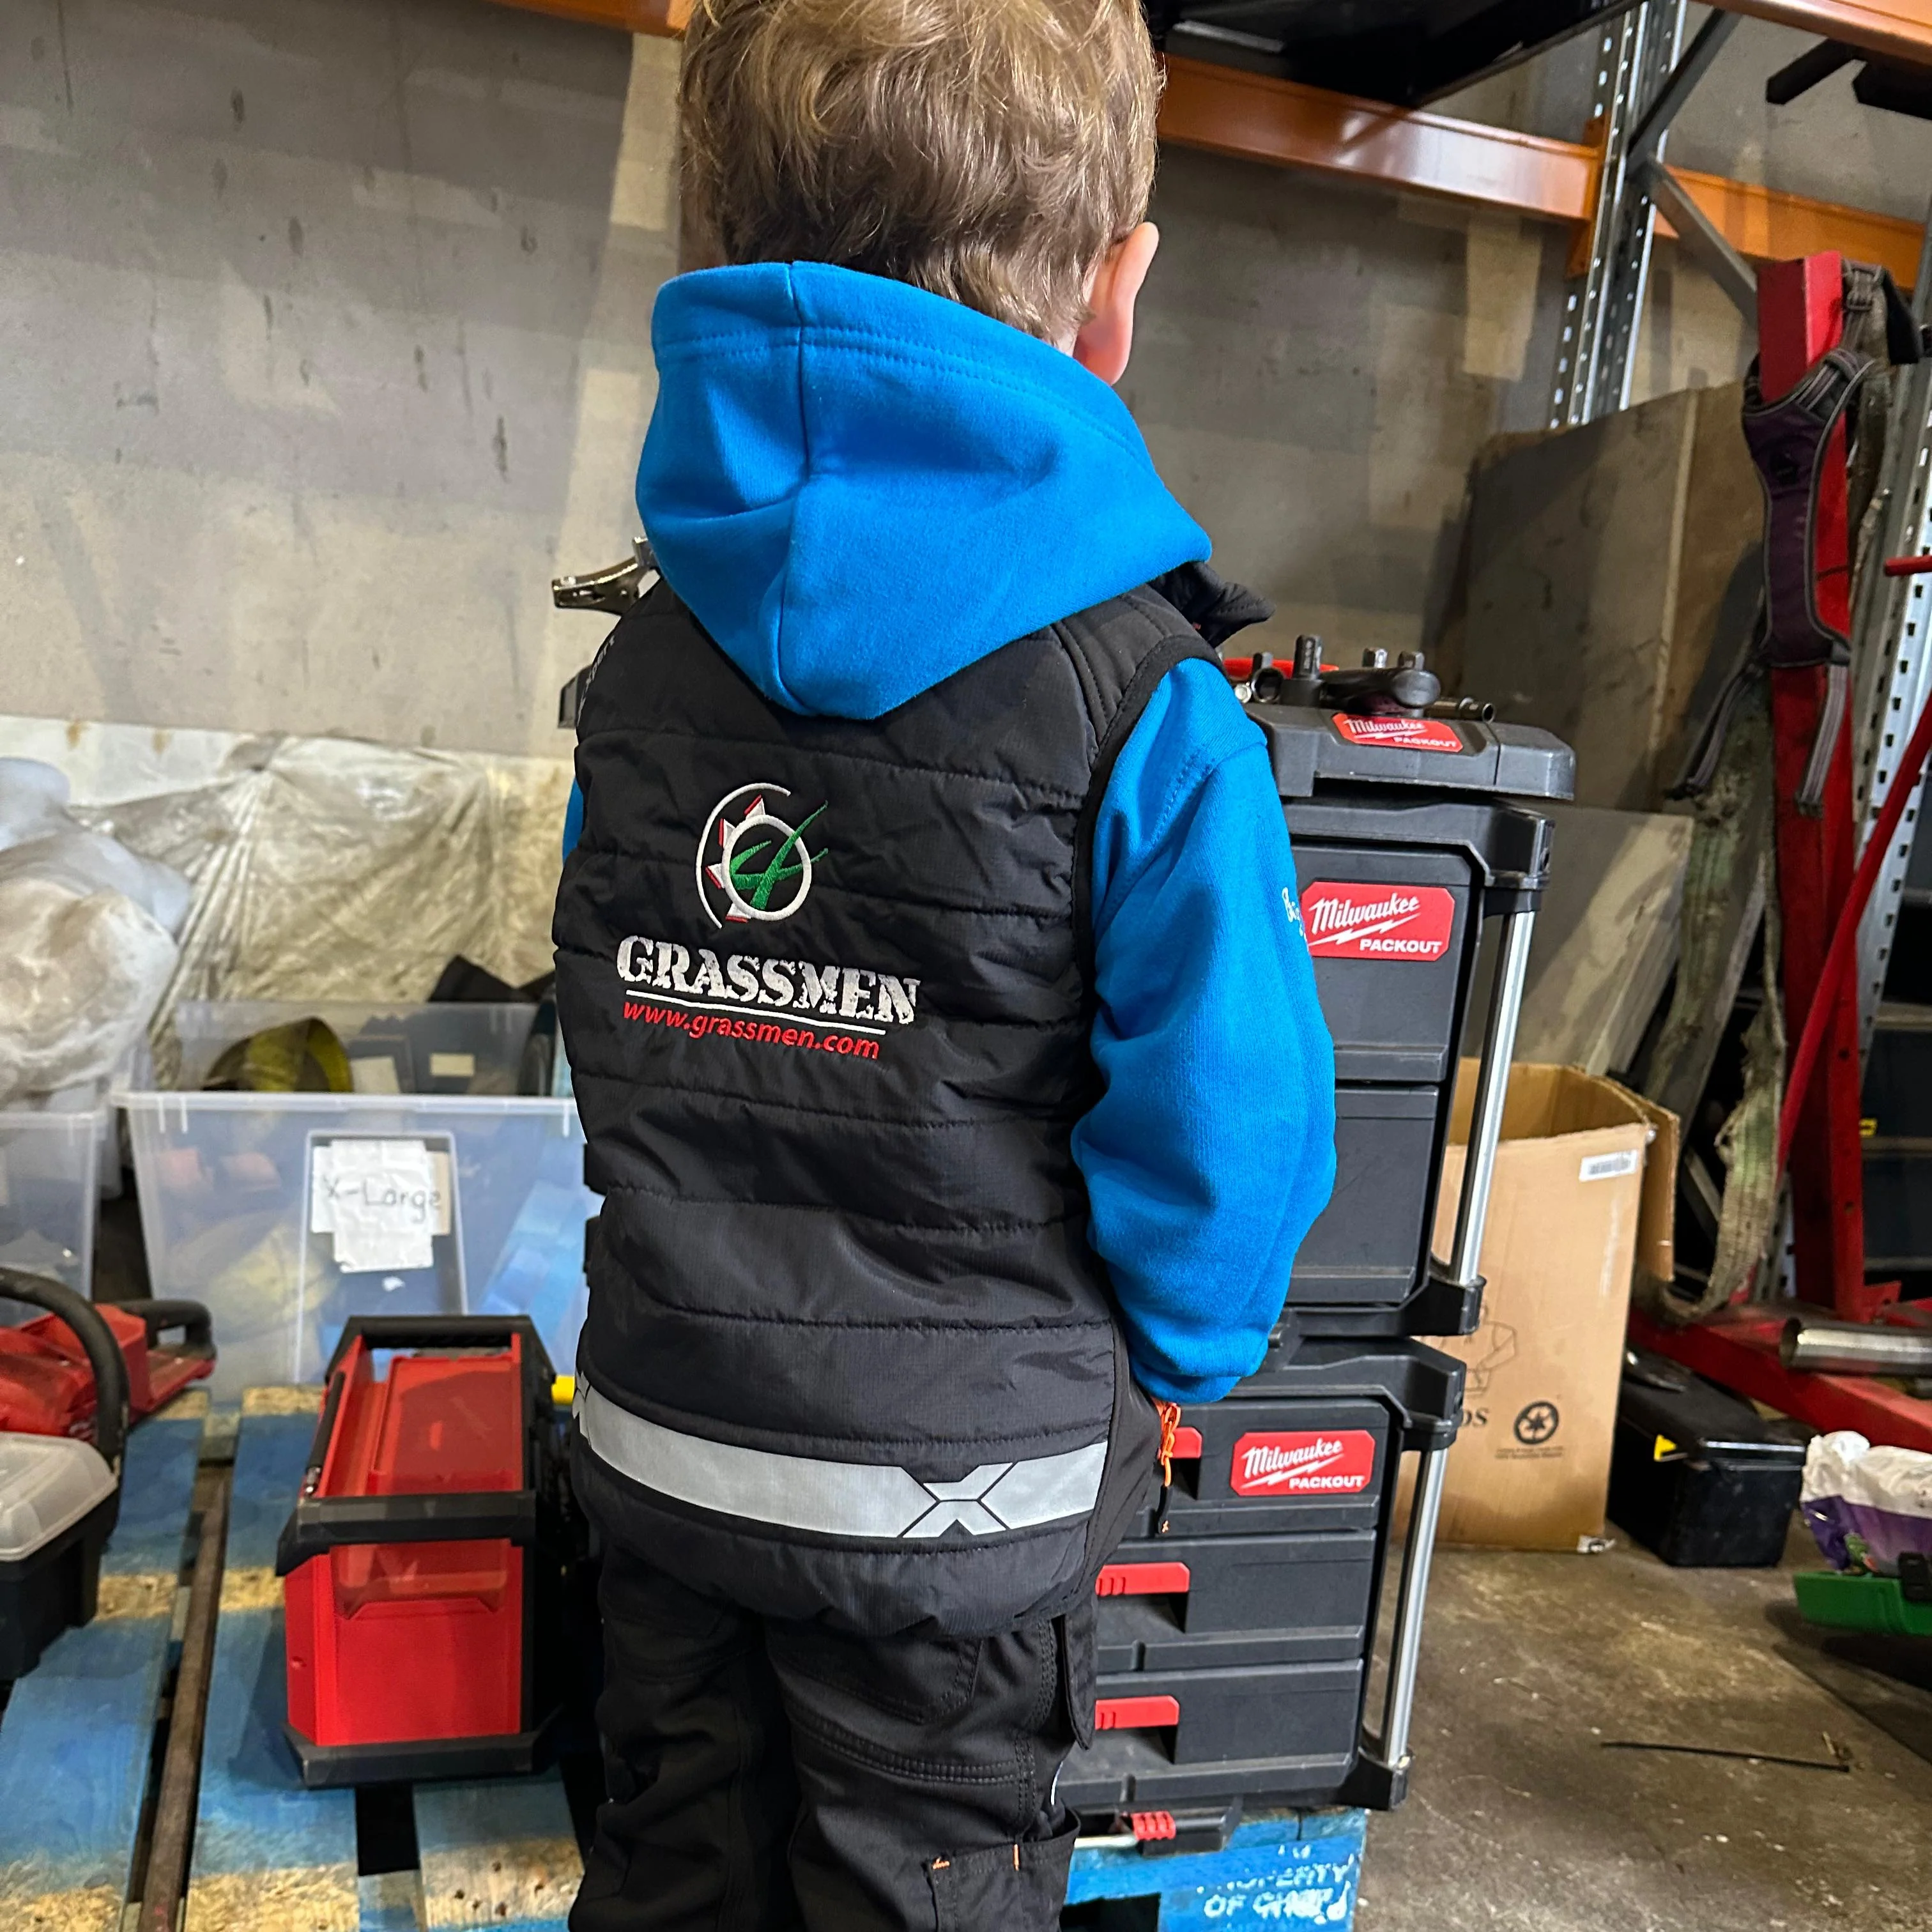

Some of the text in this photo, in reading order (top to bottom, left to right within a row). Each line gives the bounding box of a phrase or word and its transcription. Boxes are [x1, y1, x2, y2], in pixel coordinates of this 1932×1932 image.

[1344, 718, 1425, 733] Milwaukee
[1393, 736, 1457, 747] PACKOUT
[1308, 892, 1421, 935] Milwaukee
[1359, 938, 1443, 954] PACKOUT
[616, 935, 921, 1025] GRASSMEN
[622, 1000, 880, 1060] www.grassmen.com
[323, 1174, 441, 1225] X-Large
[1241, 1438, 1344, 1479] Milwaukee
[1289, 1475, 1365, 1490] PACKOUT
[1204, 1893, 1246, 1919] OF
